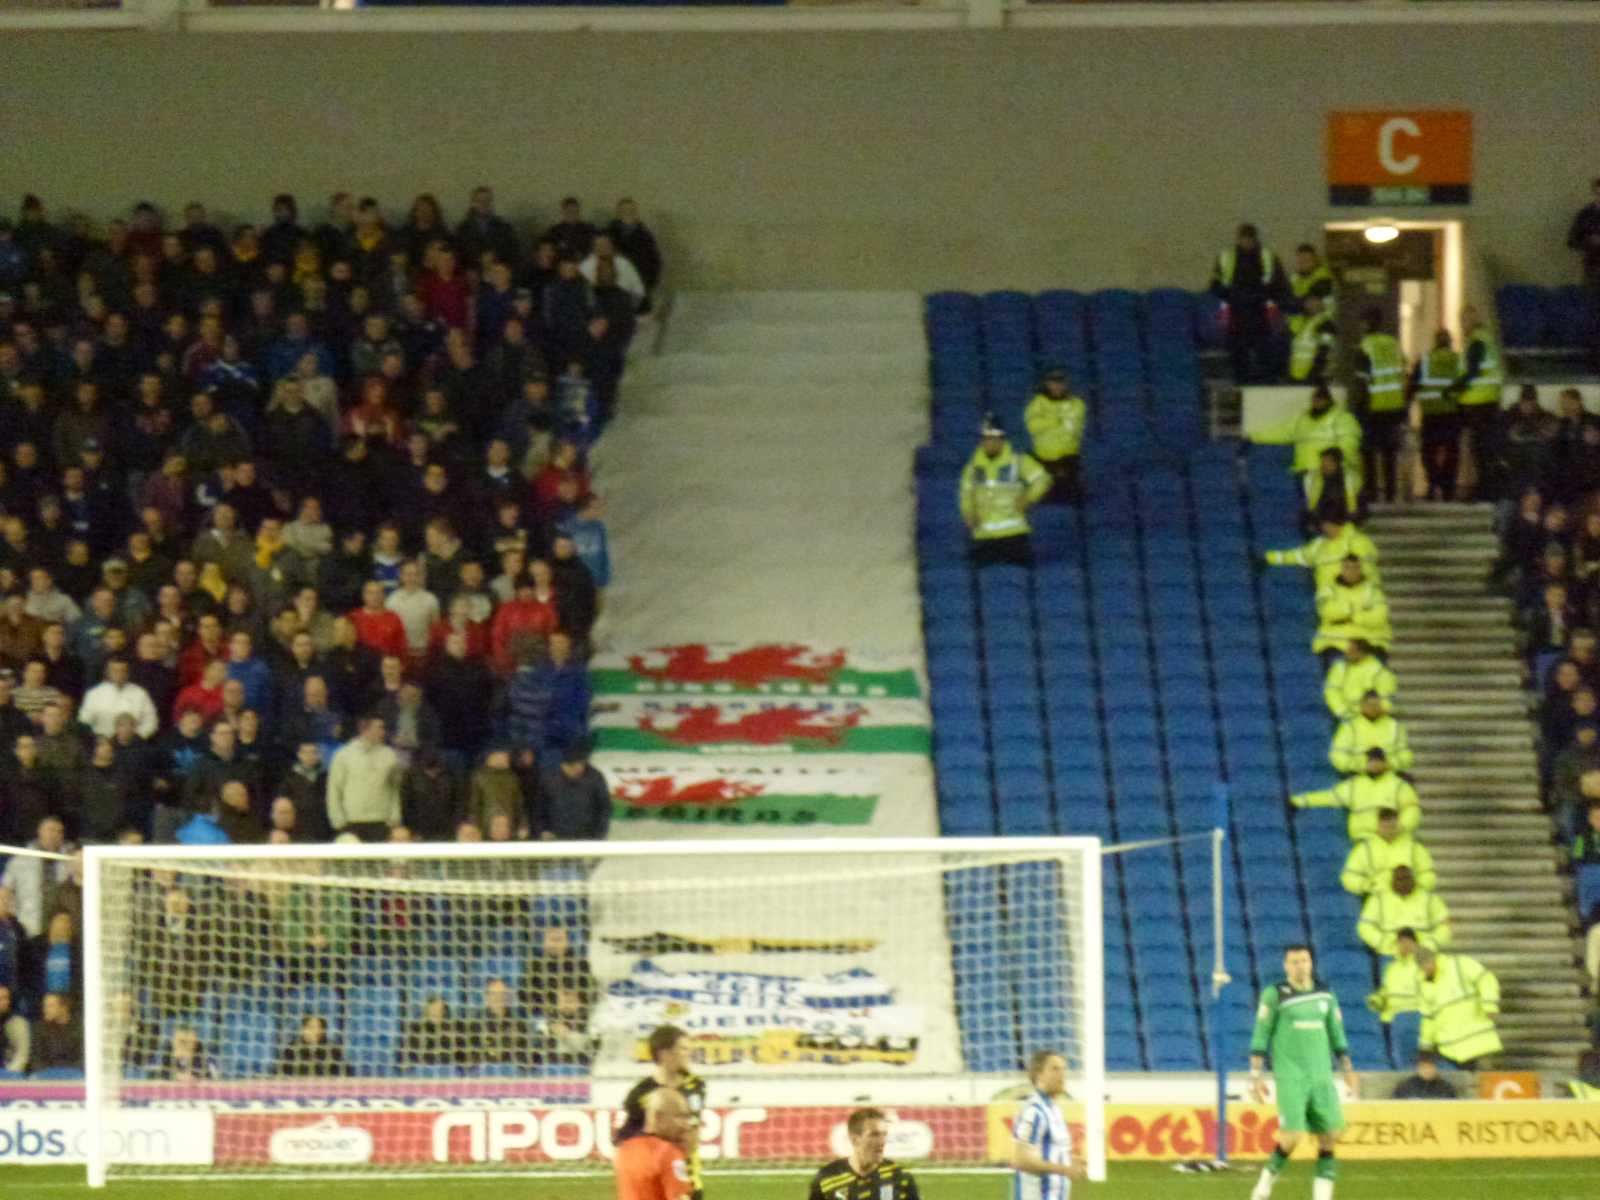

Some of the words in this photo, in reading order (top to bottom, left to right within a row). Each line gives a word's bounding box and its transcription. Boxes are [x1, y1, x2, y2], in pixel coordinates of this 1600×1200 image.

[1378, 117, 1422, 175] C
[1309, 1119, 1439, 1146] ZZERIA
[1457, 1118, 1600, 1145] RISTORAN
